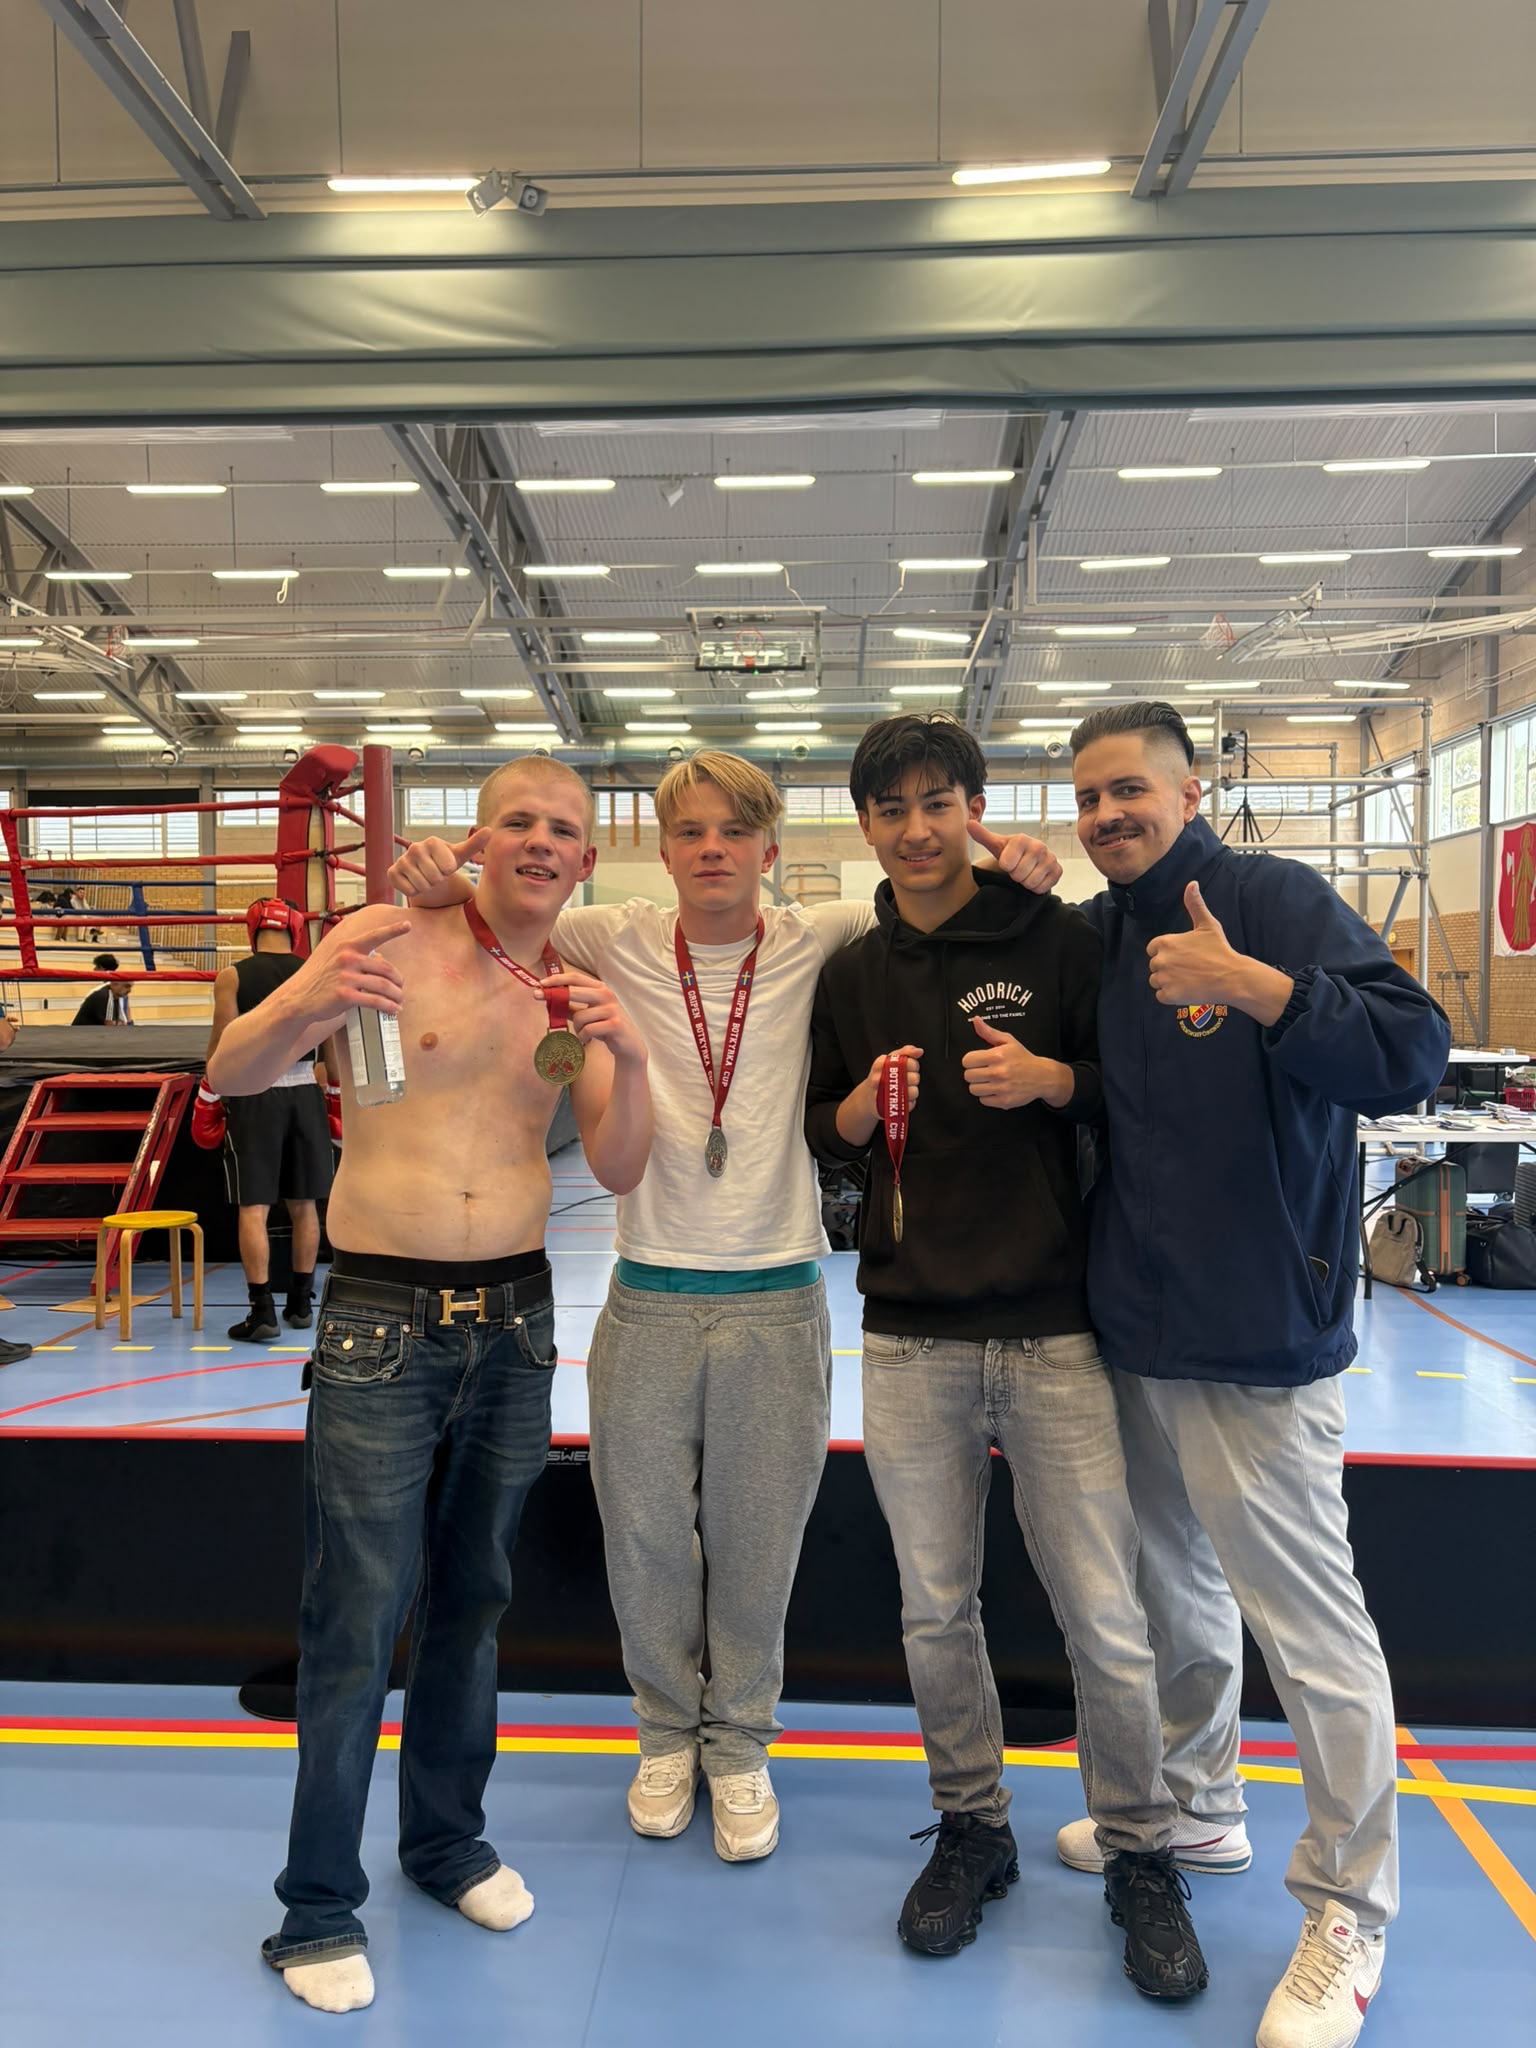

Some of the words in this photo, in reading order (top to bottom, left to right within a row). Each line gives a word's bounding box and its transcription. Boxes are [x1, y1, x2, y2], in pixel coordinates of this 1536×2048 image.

[734, 990, 747, 1019] GRIPEN
[957, 981, 1033, 1014] HOODRICH
[687, 990, 701, 1019] GRIPEN
[695, 1022, 710, 1067] BOTKYRKA
[725, 1022, 741, 1067] BOTKYRKA
[721, 1071, 731, 1088] CUP
[889, 1066, 899, 1118] BOTKYRKA
[889, 1122, 898, 1140] CUP
